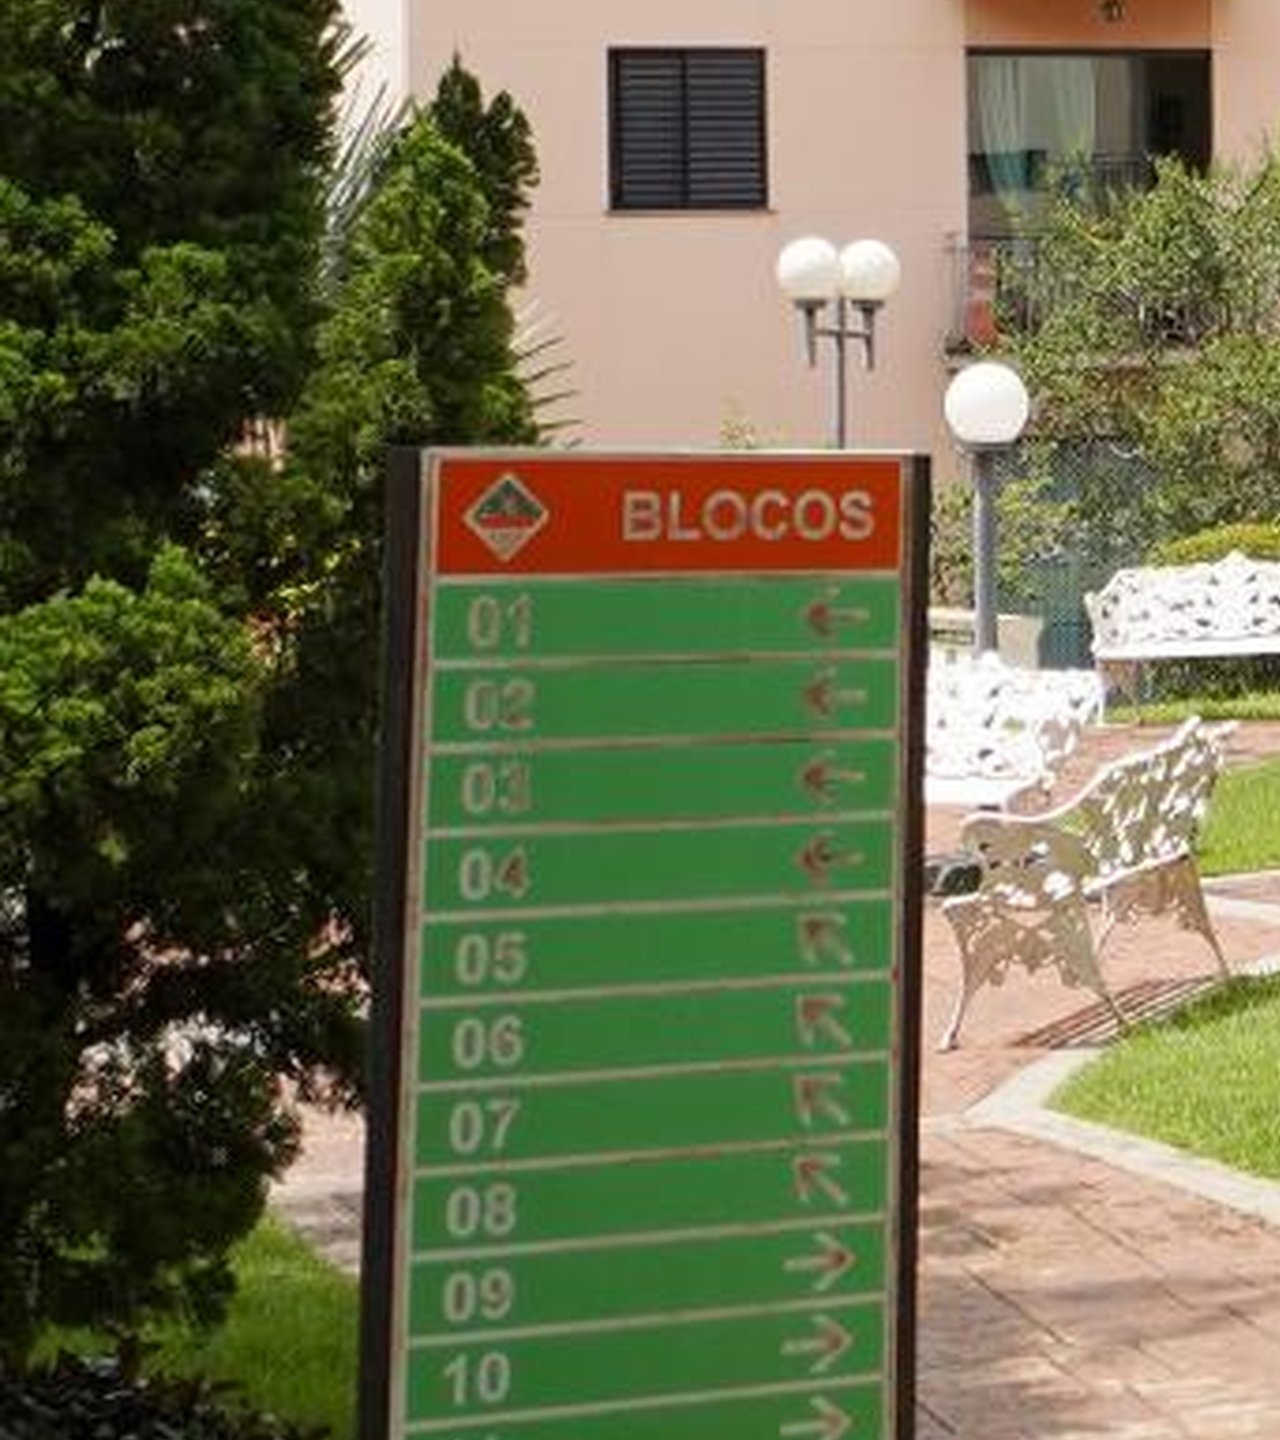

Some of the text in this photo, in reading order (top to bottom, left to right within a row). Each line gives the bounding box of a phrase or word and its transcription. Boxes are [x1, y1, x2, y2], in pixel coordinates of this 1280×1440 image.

[622, 490, 875, 541] BLOCOS
[468, 593, 532, 649] 01
[465, 679, 535, 730] 02
[462, 763, 531, 815] 03
[459, 848, 529, 901] 04
[456, 932, 526, 986] 05
[452, 1015, 523, 1069] 06
[449, 1100, 519, 1154] 07
[446, 1183, 516, 1237] 08
[444, 1268, 514, 1323] 09
[443, 1352, 510, 1406] 10
